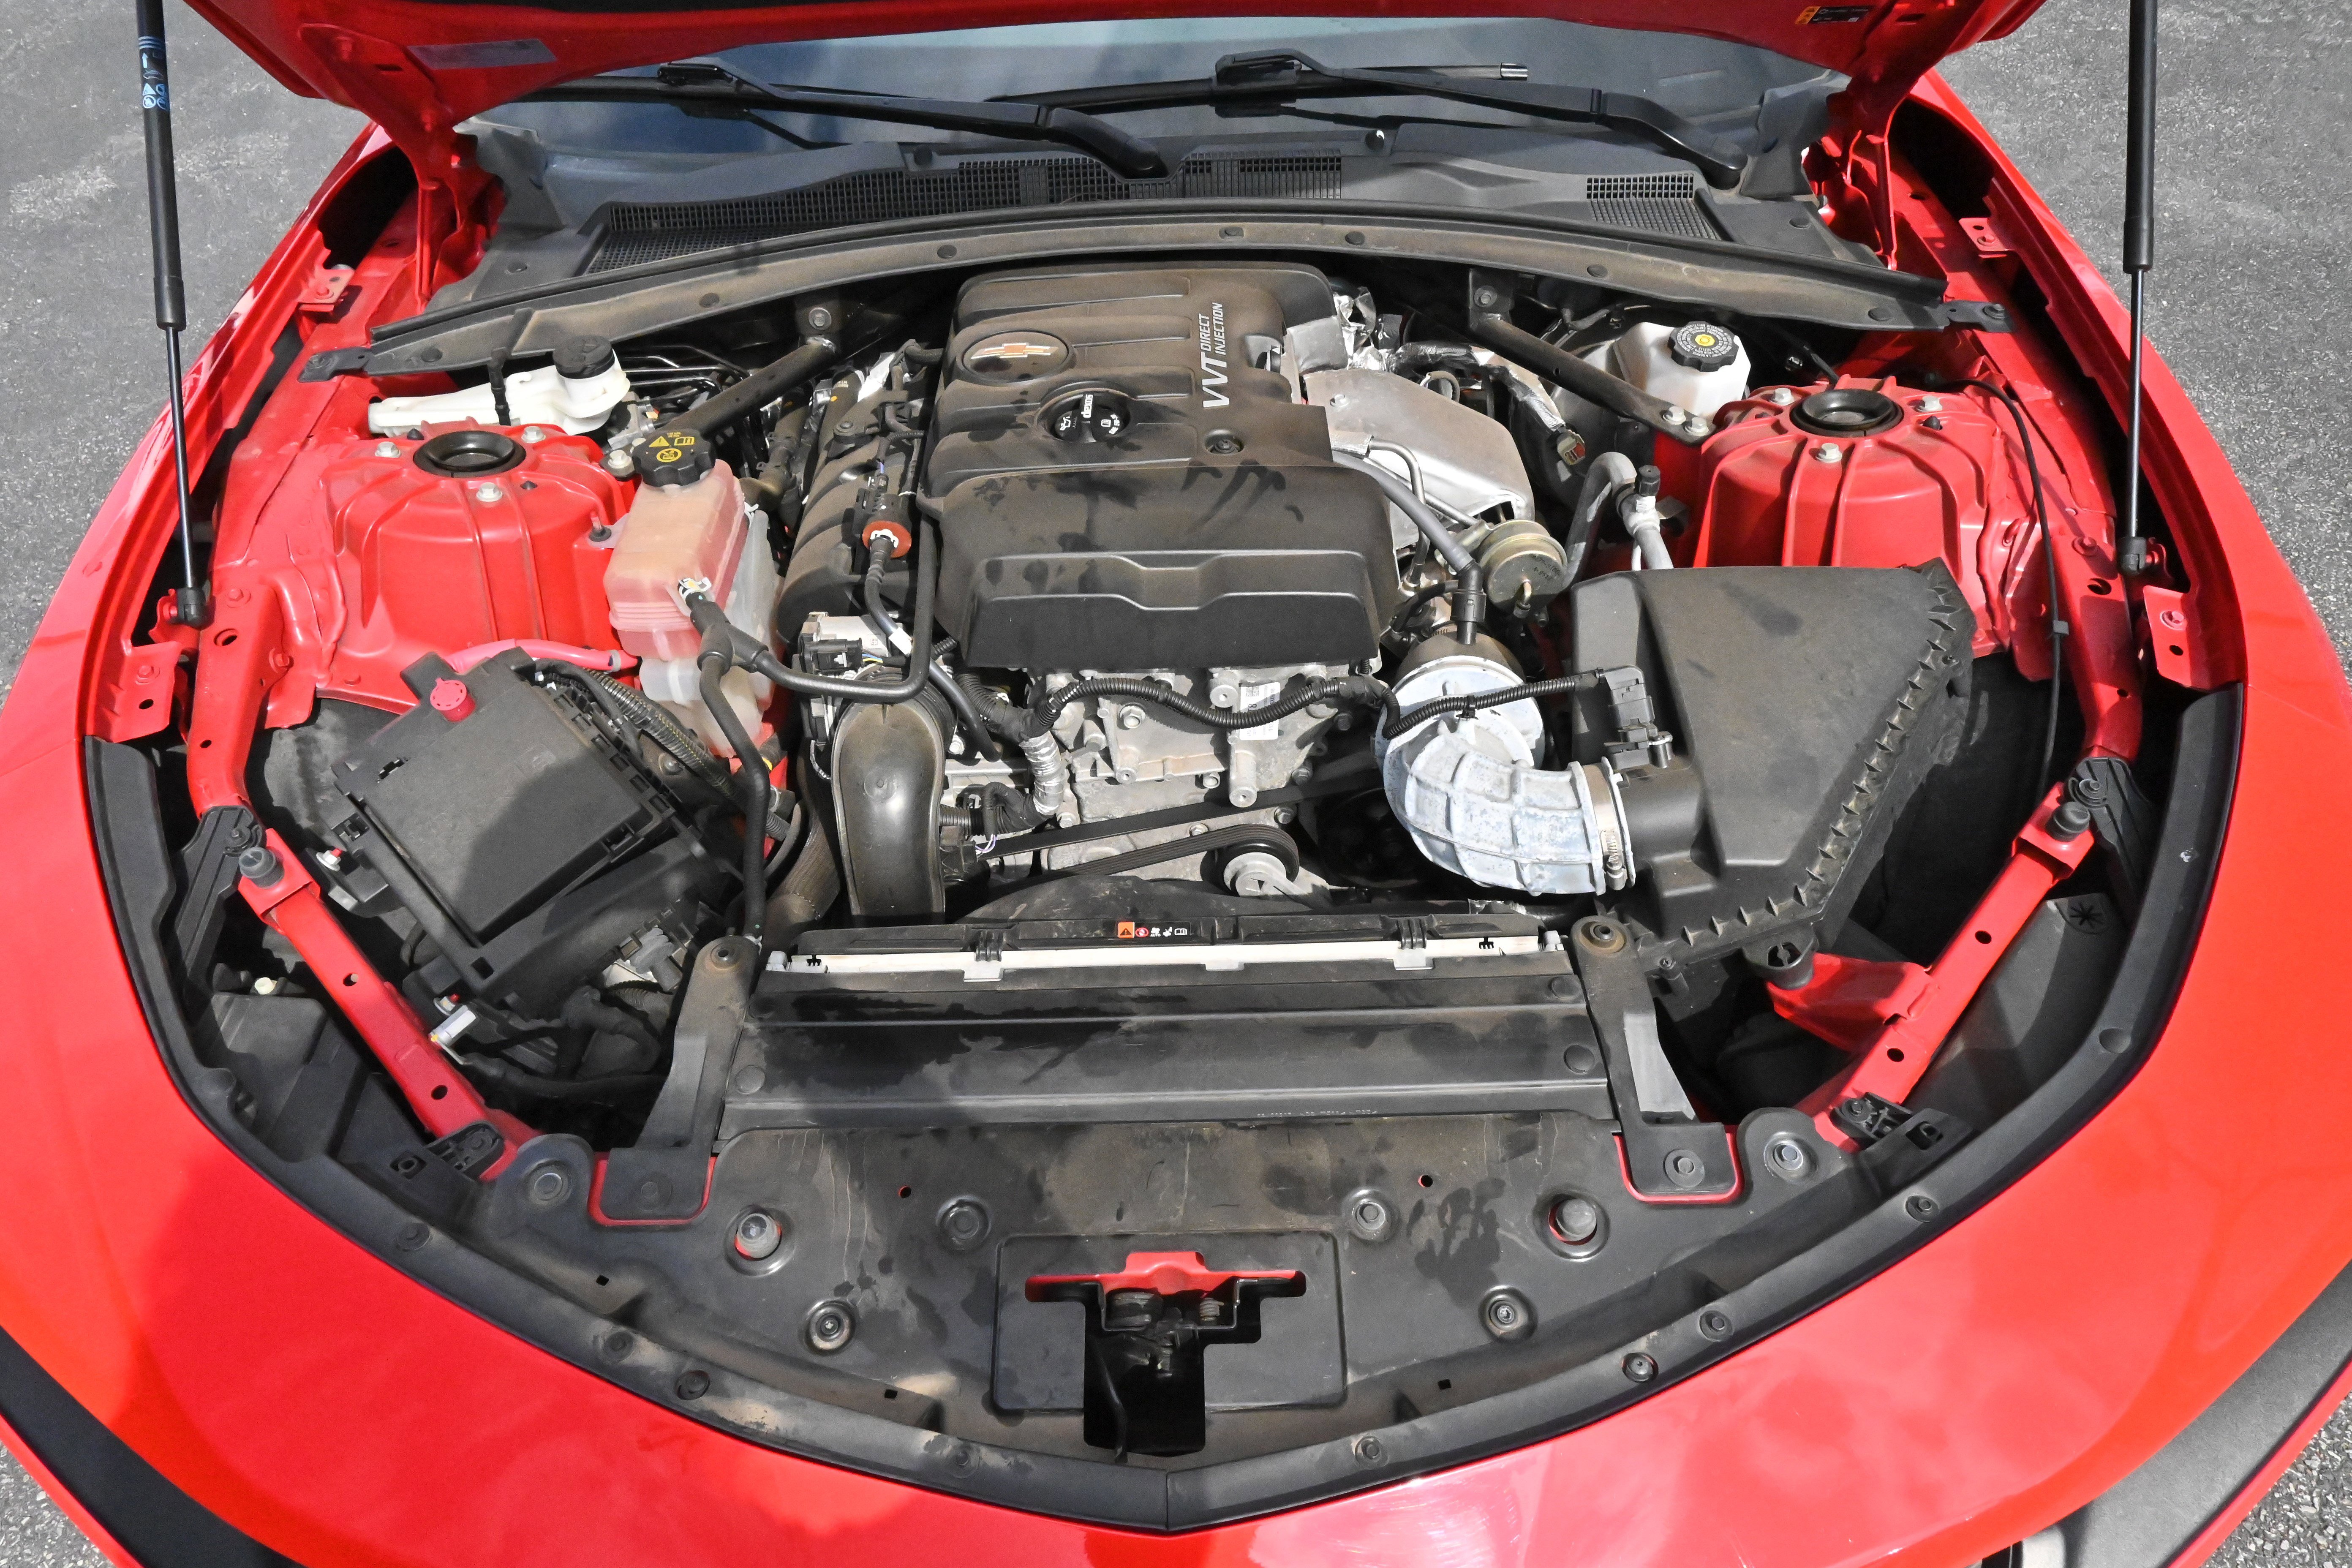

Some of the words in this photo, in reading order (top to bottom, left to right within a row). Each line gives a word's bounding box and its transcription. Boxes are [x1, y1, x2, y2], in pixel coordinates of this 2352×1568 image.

[1198, 313, 1211, 352] DIRECT
[1212, 302, 1226, 355] INJECTION
[1201, 351, 1230, 408] VVT
[1081, 394, 1093, 418] dexos
